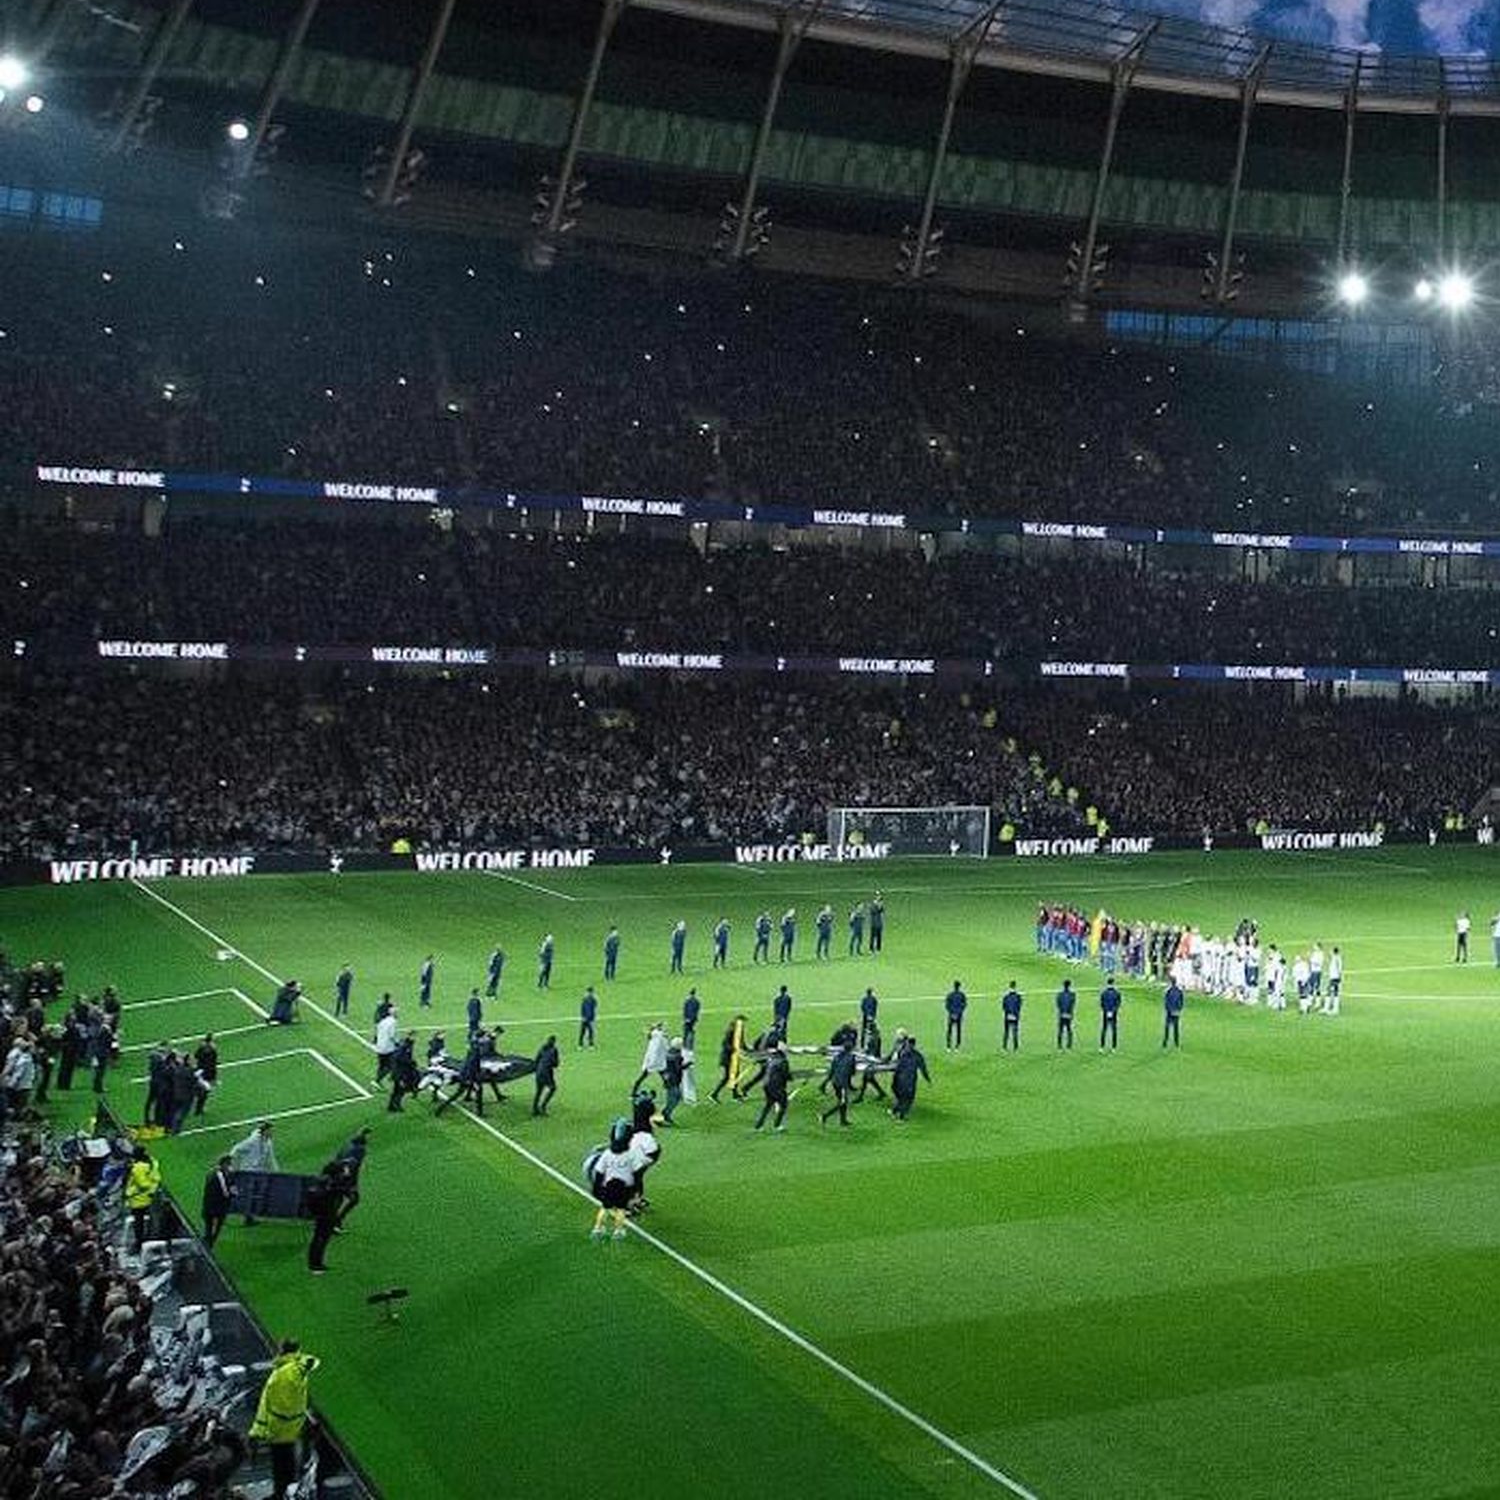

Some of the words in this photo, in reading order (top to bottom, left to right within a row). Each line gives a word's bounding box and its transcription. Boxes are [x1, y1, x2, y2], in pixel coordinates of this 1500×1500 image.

[38, 466, 115, 485] WELCOME
[117, 471, 165, 487] HOME
[325, 483, 394, 500] WELCOME
[396, 487, 438, 503] HOME
[582, 497, 645, 514] WELCOME
[646, 500, 684, 516] HOME
[813, 510, 870, 526] WELCOME
[871, 514, 905, 528] HOME
[1022, 522, 1075, 536] WELCOME
[1076, 525, 1106, 538] HOME
[1212, 532, 1260, 546] WELCOME
[1261, 535, 1292, 549] HOME
[1399, 540, 1449, 553] WELCOME
[1451, 541, 1482, 554] HOME
[98, 640, 179, 658] WELCOME
[180, 642, 228, 659] HOME
[372, 647, 443, 662] WELCOME
[445, 648, 488, 664] HOME
[617, 652, 682, 667] WELCOME
[683, 654, 722, 668] HOME
[839, 658, 897, 673] WELCOME
[898, 659, 935, 674] HOME
[1041, 662, 1093, 676] WELCOME
[1094, 663, 1127, 677] HOME
[1225, 666, 1272, 679] WELCOME
[1273, 667, 1305, 680] HOME
[1404, 669, 1455, 682] WELCOME
[1456, 670, 1488, 682] HOME
[1015, 838, 1099, 856] WELCOME
[1261, 832, 1337, 850] WELCOME
[1340, 830, 1383, 848] HOME
[416, 851, 525, 870] WELCOME
[530, 849, 595, 868] HOME
[50, 858, 175, 884] WELCOME
[180, 856, 255, 877] HOME
